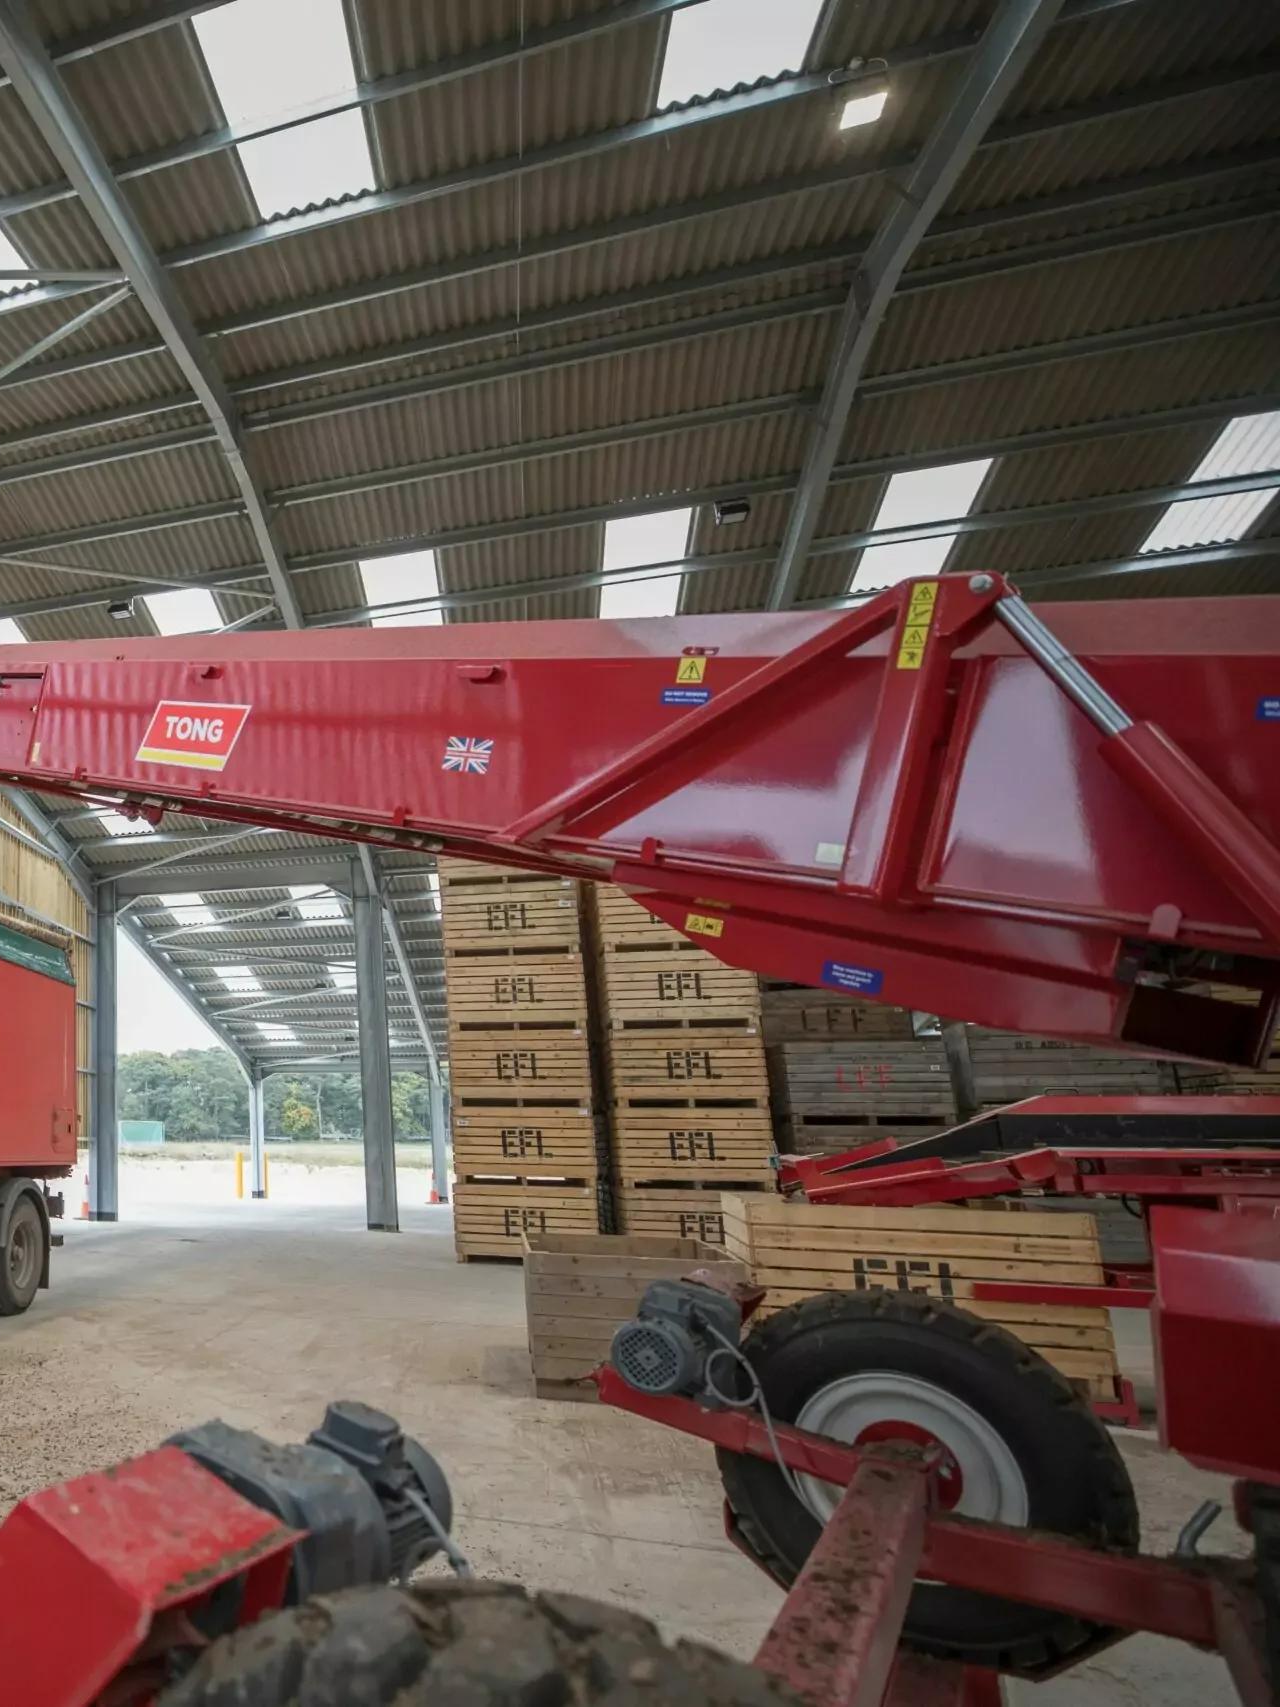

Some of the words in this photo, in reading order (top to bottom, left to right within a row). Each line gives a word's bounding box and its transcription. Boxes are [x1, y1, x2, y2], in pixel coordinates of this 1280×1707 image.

[166, 716, 224, 743] TONG
[487, 904, 536, 930] EFL
[495, 977, 544, 1004] EFL
[658, 973, 712, 1000] EFL
[496, 1053, 547, 1080] EFL
[666, 1051, 723, 1080] EFL
[501, 1130, 553, 1158] EFL
[669, 1132, 727, 1161] EFL
